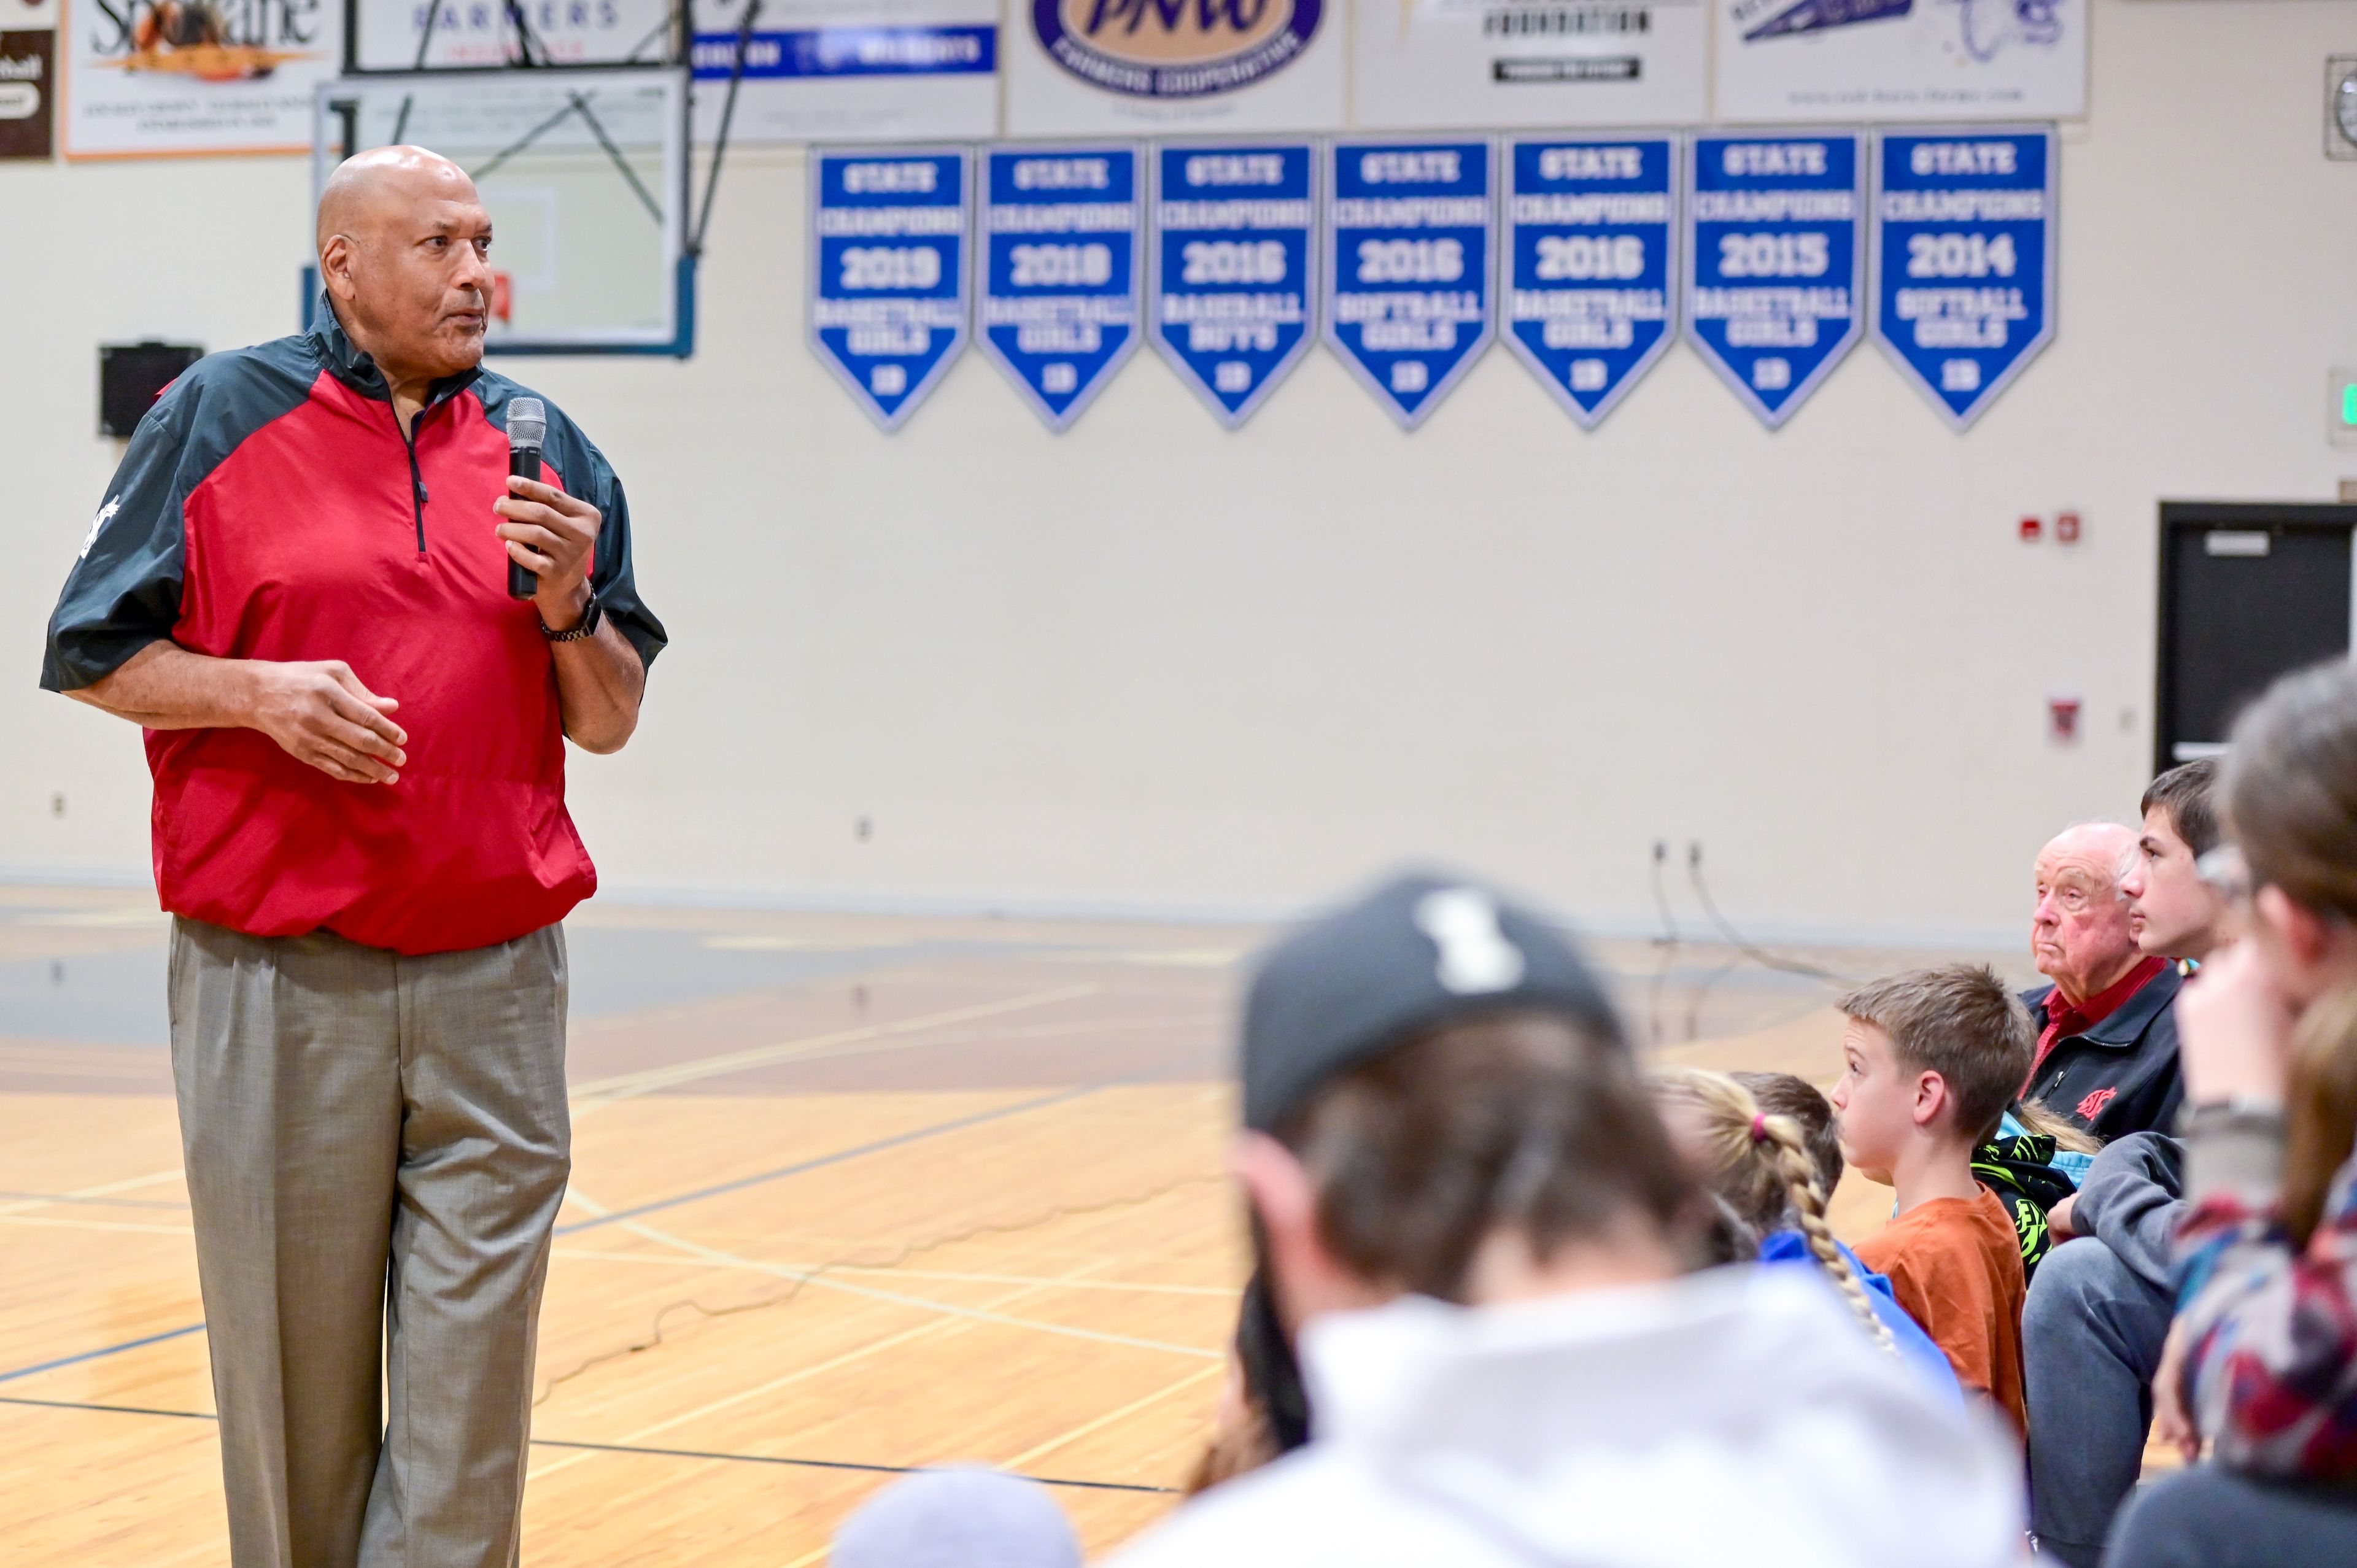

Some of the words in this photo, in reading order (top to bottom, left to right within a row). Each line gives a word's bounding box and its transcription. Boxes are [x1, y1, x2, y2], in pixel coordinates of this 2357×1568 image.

[1484, 10, 1652, 36] FOUNDATION
[1188, 155, 1282, 184] STATE
[1363, 153, 1459, 181] STATE
[1540, 150, 1640, 178] STATE
[1724, 145, 1825, 174] STATE
[1911, 144, 2016, 174] STATE
[845, 164, 935, 191] STATE
[1017, 160, 1105, 188] STATE
[989, 204, 1134, 231] CHAMPIONS
[1159, 201, 1309, 228] CHAMPIONS
[1335, 199, 1487, 225] CHAMPIONS
[1512, 196, 1668, 222] CHAMPIONS
[1695, 191, 1854, 219] CHAMPIONS
[1882, 191, 2045, 218] CHAMPIONS
[819, 208, 961, 234] CHAMPIONS
[1184, 242, 1285, 281] 2016
[1359, 240, 1463, 280] 2016
[1538, 238, 1643, 277] 2016
[1720, 235, 1827, 275] 2015
[1908, 236, 2014, 276] 2014
[1163, 295, 1302, 322] BASEBALL
[1336, 294, 1482, 320] SOFTBALL
[1512, 292, 1665, 318] BASKETBALL
[1693, 289, 1850, 317] BASKETBALL
[1898, 290, 2026, 317] SOFTBALL
[850, 326, 929, 353] GIRLS
[1020, 324, 1099, 352] GIRLS
[1191, 323, 1275, 350] BOYS
[1364, 320, 1455, 349] GIRLS
[1544, 319, 1631, 346] GIRLS
[1728, 317, 1816, 345] GIRLS
[1916, 318, 2007, 346] GIRLS
